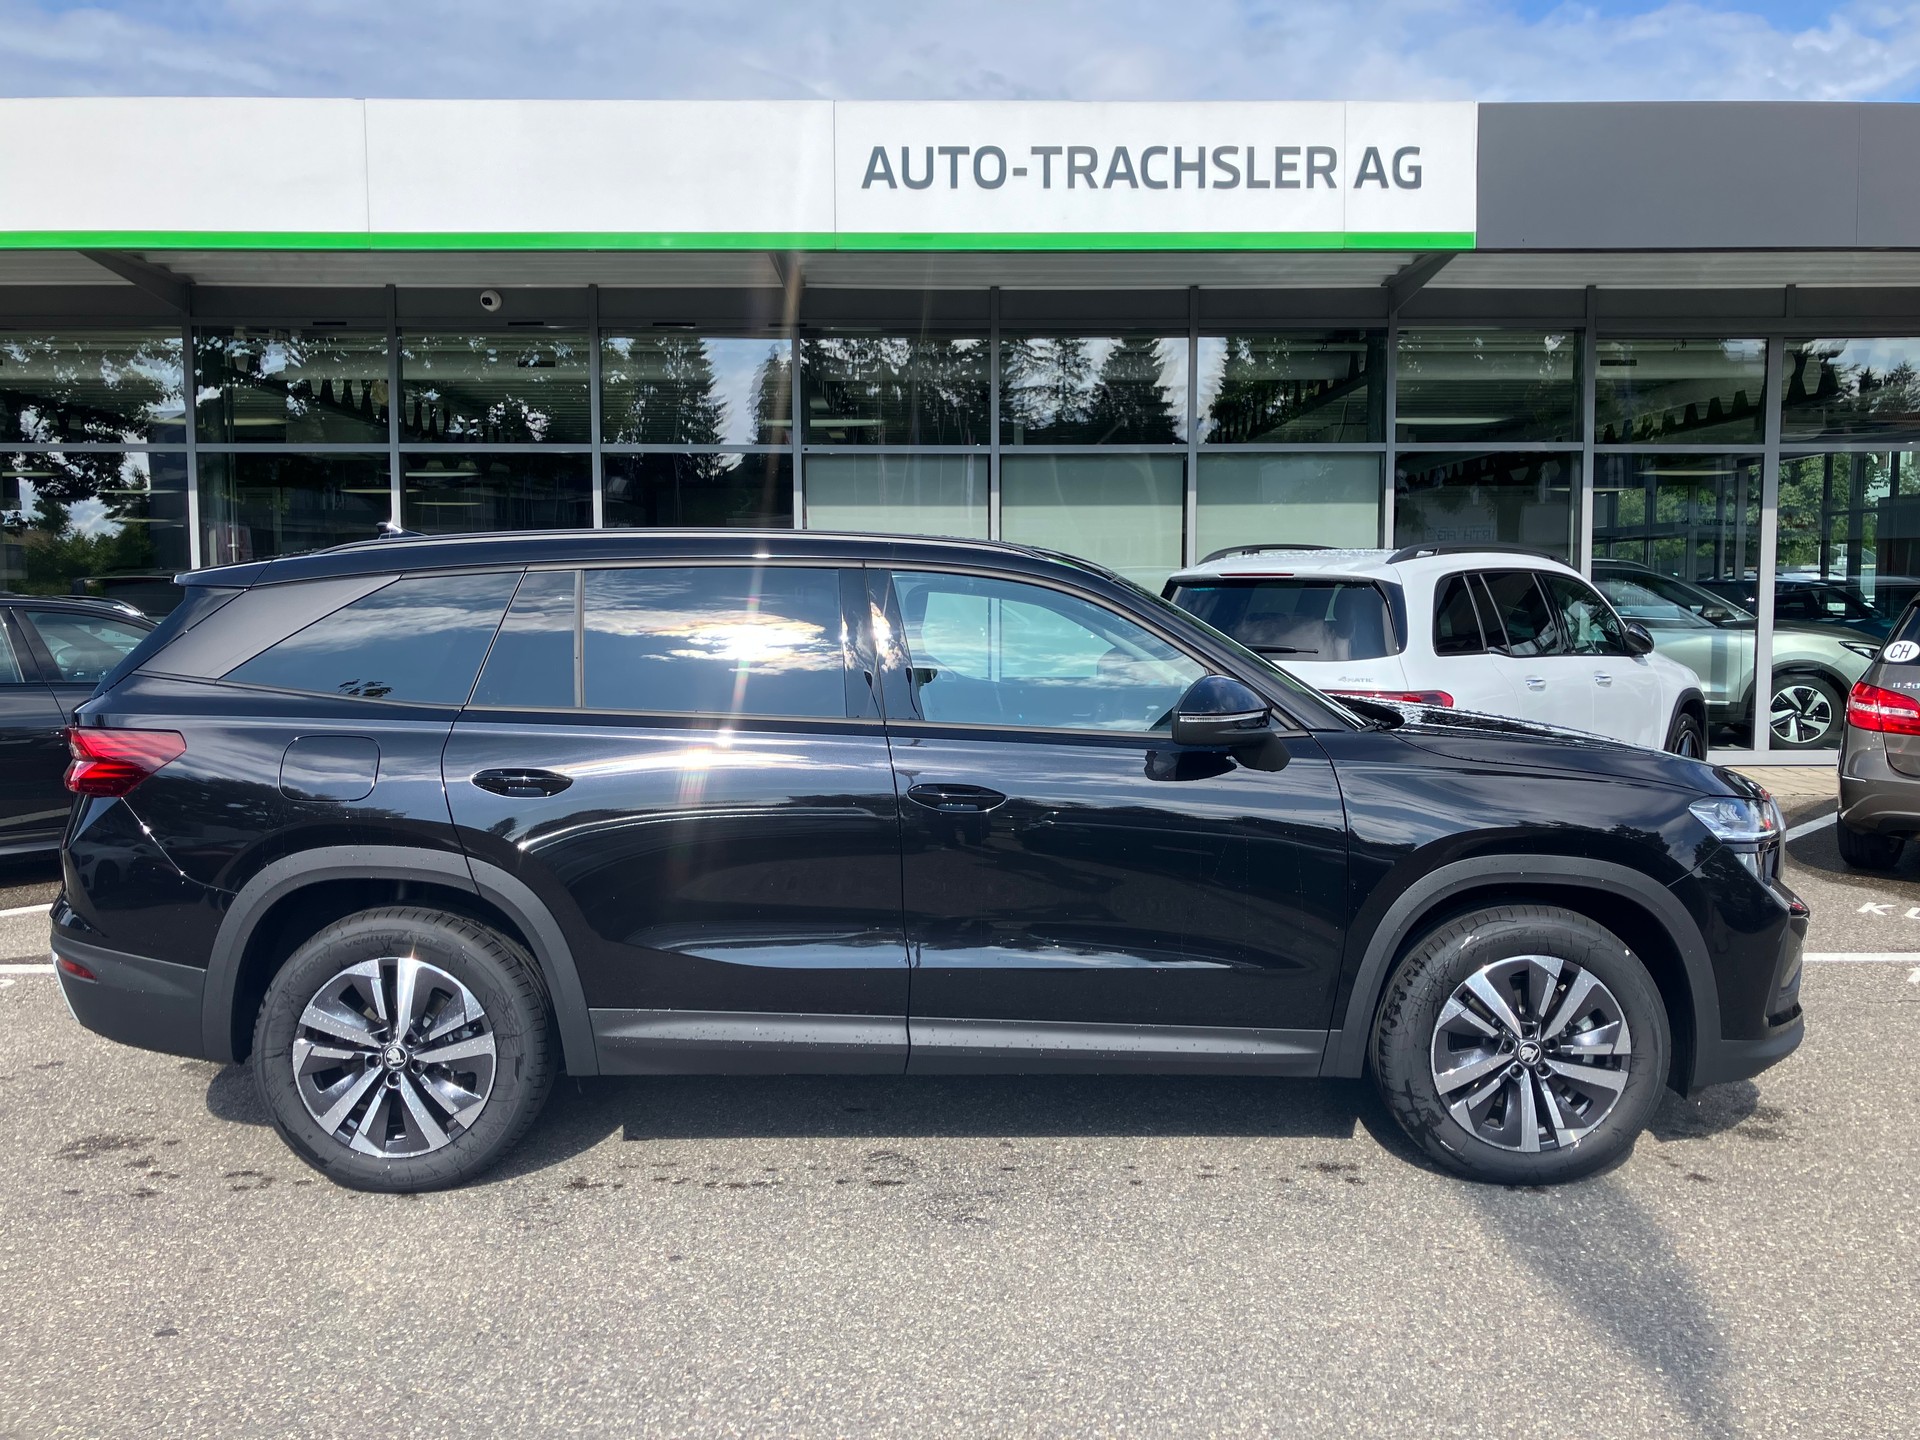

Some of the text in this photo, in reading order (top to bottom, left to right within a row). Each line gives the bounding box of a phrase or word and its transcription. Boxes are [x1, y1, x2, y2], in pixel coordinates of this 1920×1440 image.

[861, 145, 1422, 190] AUTO-TRACHSLER AG
[1889, 643, 1913, 659] CH
